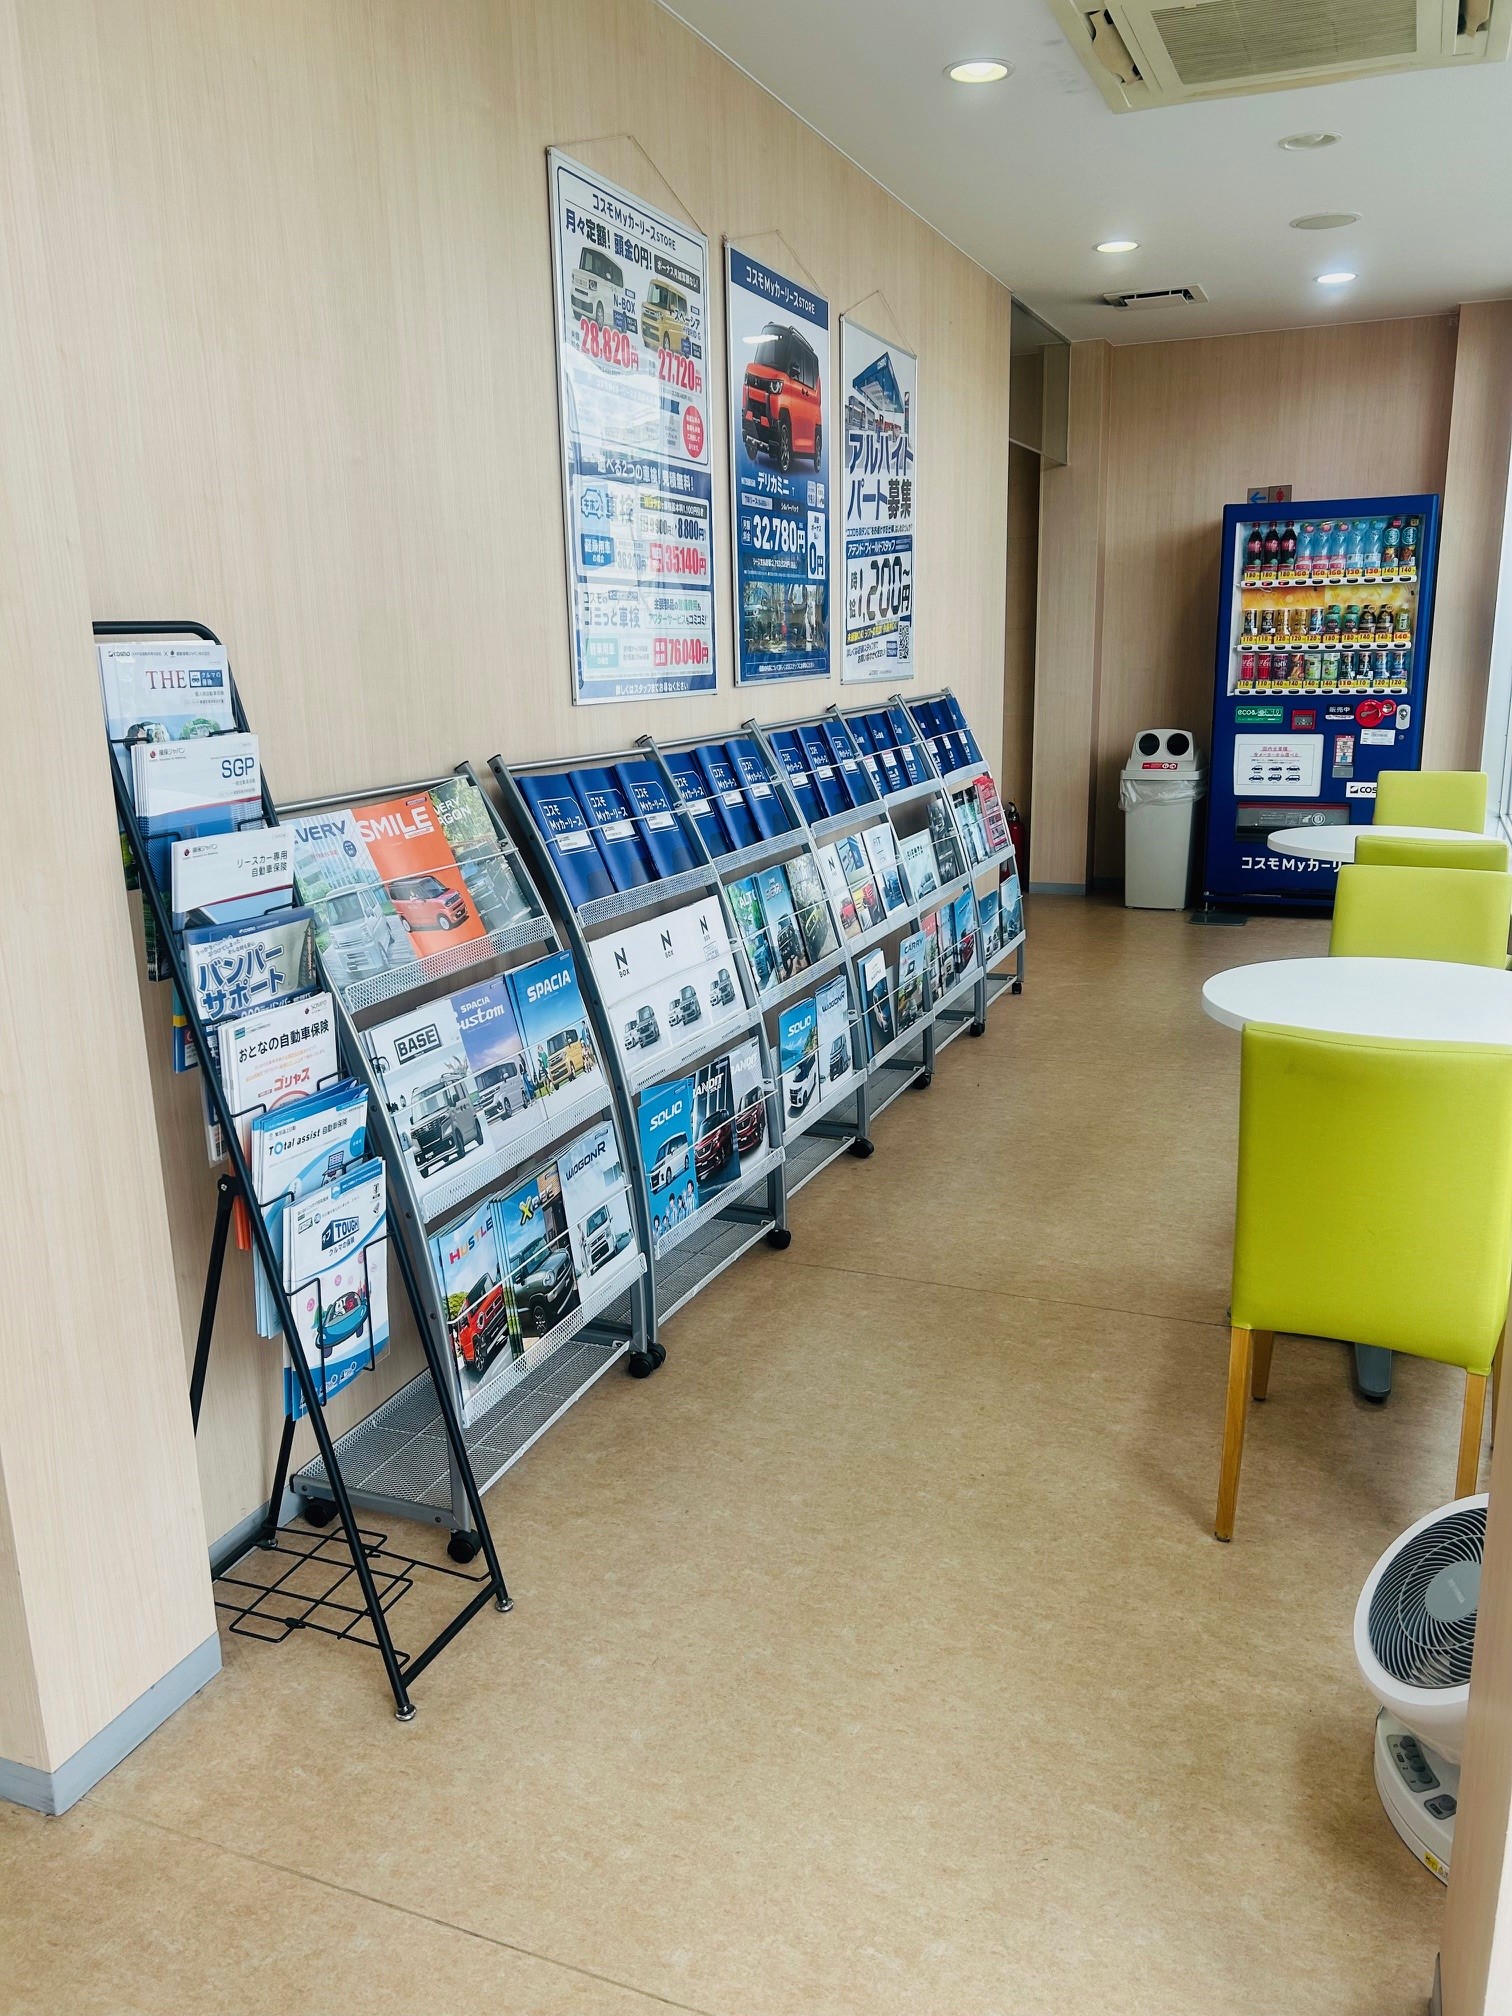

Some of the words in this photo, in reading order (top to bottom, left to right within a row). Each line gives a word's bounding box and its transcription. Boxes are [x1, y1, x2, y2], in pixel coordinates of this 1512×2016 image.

[565, 207, 611, 250] 月々定額!
[613, 232, 653, 271] 頭金0円!
[613, 293, 636, 315] N-BOX
[849, 431, 914, 477] アルバイト
[757, 471, 791, 496] デリカミニ
[847, 478, 912, 521] パート募集
[752, 514, 806, 555] 32,780円
[145, 669, 188, 690] THE
[159, 747, 186, 756] 損保ジャパン
[221, 757, 255, 779] SGP
[590, 796, 607, 808] コスモ
[634, 787, 649, 799] コスモ
[543, 804, 561, 817] コスモ
[295, 820, 347, 844] VERY
[356, 806, 433, 843] SMILE
[236, 850, 288, 869] リースカー専用
[251, 861, 288, 878] 自動車保険
[699, 915, 709, 935] N
[660, 929, 673, 951] N
[904, 936, 925, 954] CARRY
[198, 942, 284, 992] バンパー
[613, 946, 629, 971] N
[618, 968, 631, 978] BOX
[201, 965, 286, 1021] サポート
[526, 969, 572, 1004] SPACIA
[460, 995, 491, 1014] SPACIA
[787, 1014, 812, 1038] SOLIO
[238, 1018, 330, 1064] おとなの自動車保険
[397, 1028, 439, 1059] BASE
[649, 1100, 683, 1132] SOLIO
[296, 1128, 321, 1146] assist
[334, 1219, 359, 1239] TOUGH
[449, 1216, 494, 1265] HUSTLE
